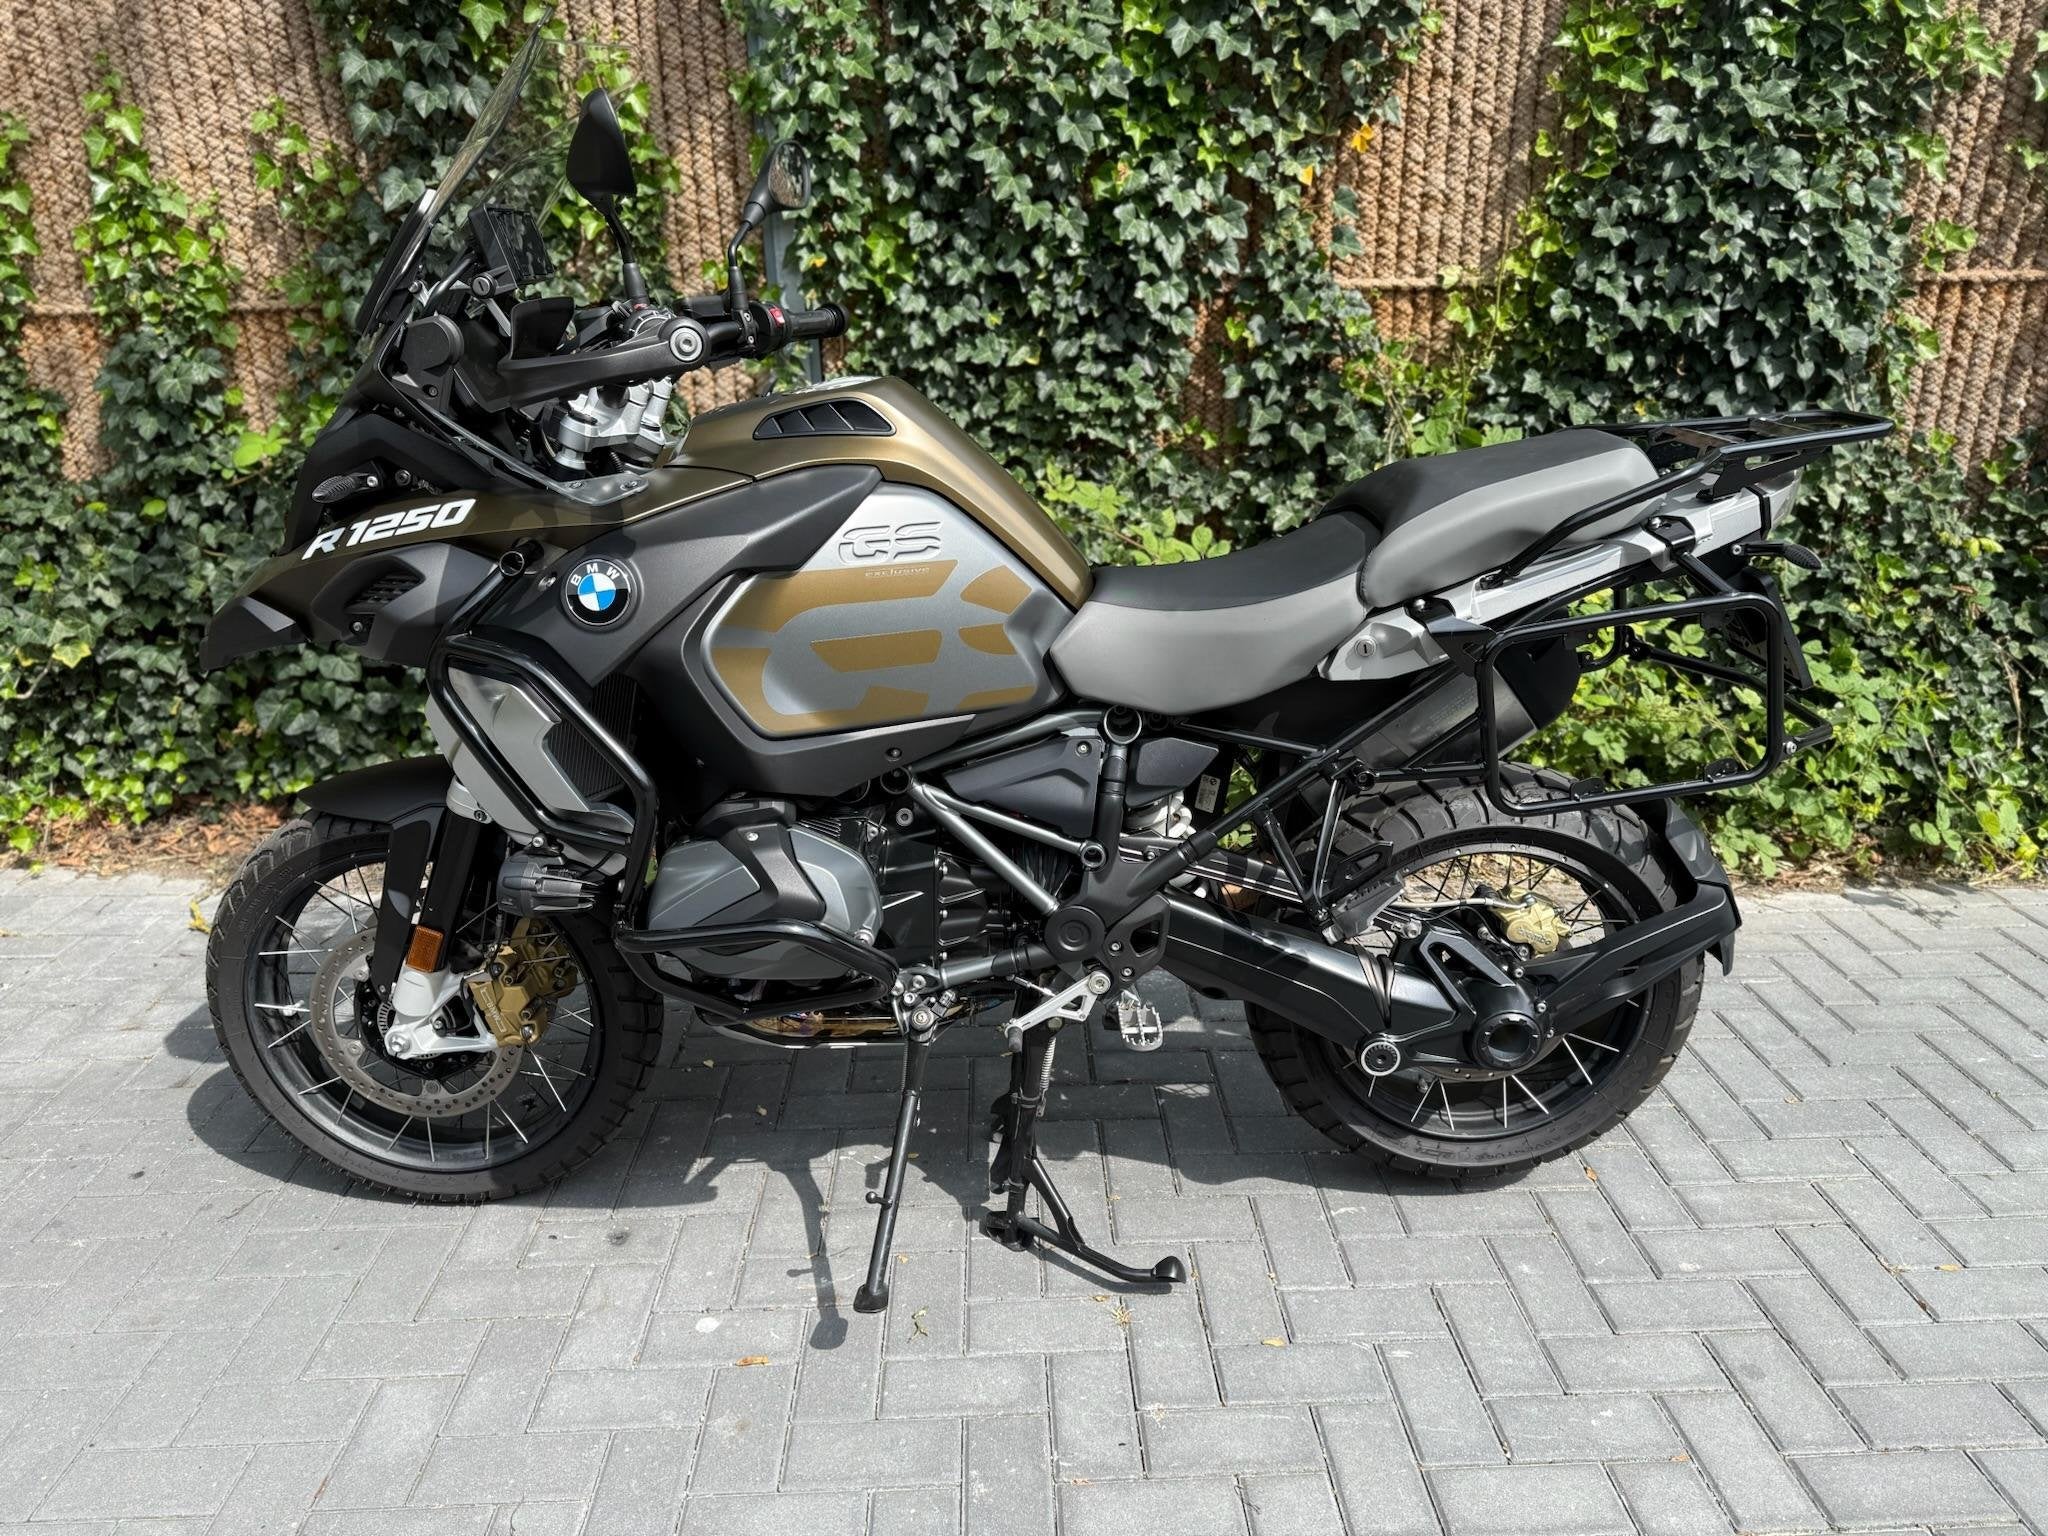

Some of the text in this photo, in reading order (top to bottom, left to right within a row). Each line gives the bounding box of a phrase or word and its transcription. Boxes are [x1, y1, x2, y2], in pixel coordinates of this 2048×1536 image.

[301, 499, 476, 560] R 1250
[838, 521, 941, 564] GS
[571, 563, 620, 586] BMW
